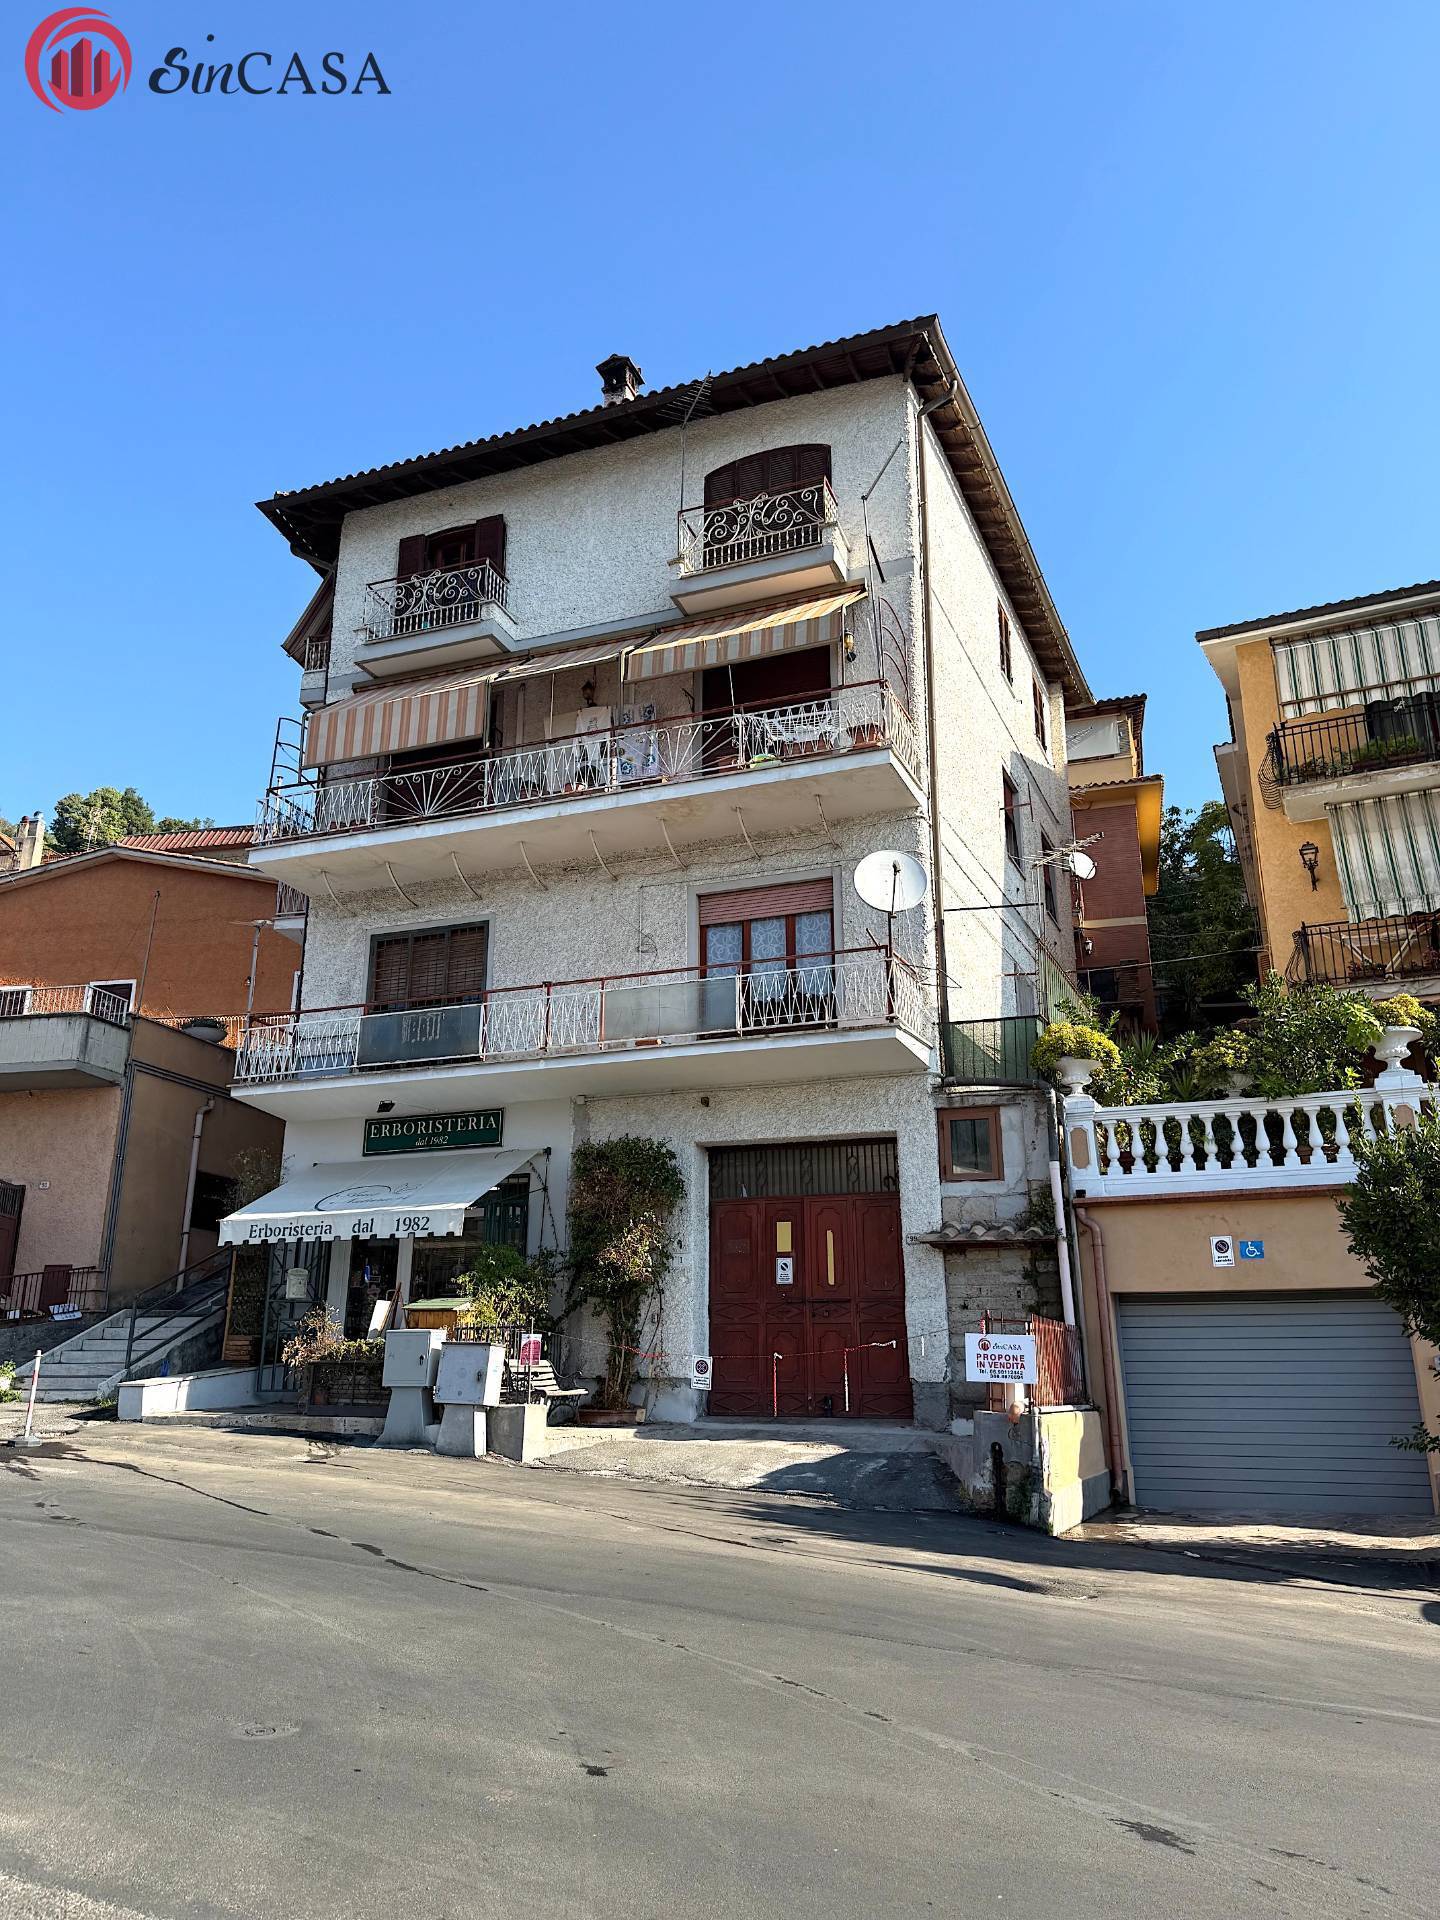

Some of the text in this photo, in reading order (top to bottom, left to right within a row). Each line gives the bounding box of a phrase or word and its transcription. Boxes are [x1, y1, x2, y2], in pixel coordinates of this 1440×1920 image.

[370, 1116, 497, 1138] ERBORISTERIA
[415, 1135, 449, 1146] dal 1982
[249, 1216, 430, 1239] Erboristeria dal 1982
[976, 1353, 1025, 1362] PROPONE
[988, 1362, 1026, 1370] VENDITA
